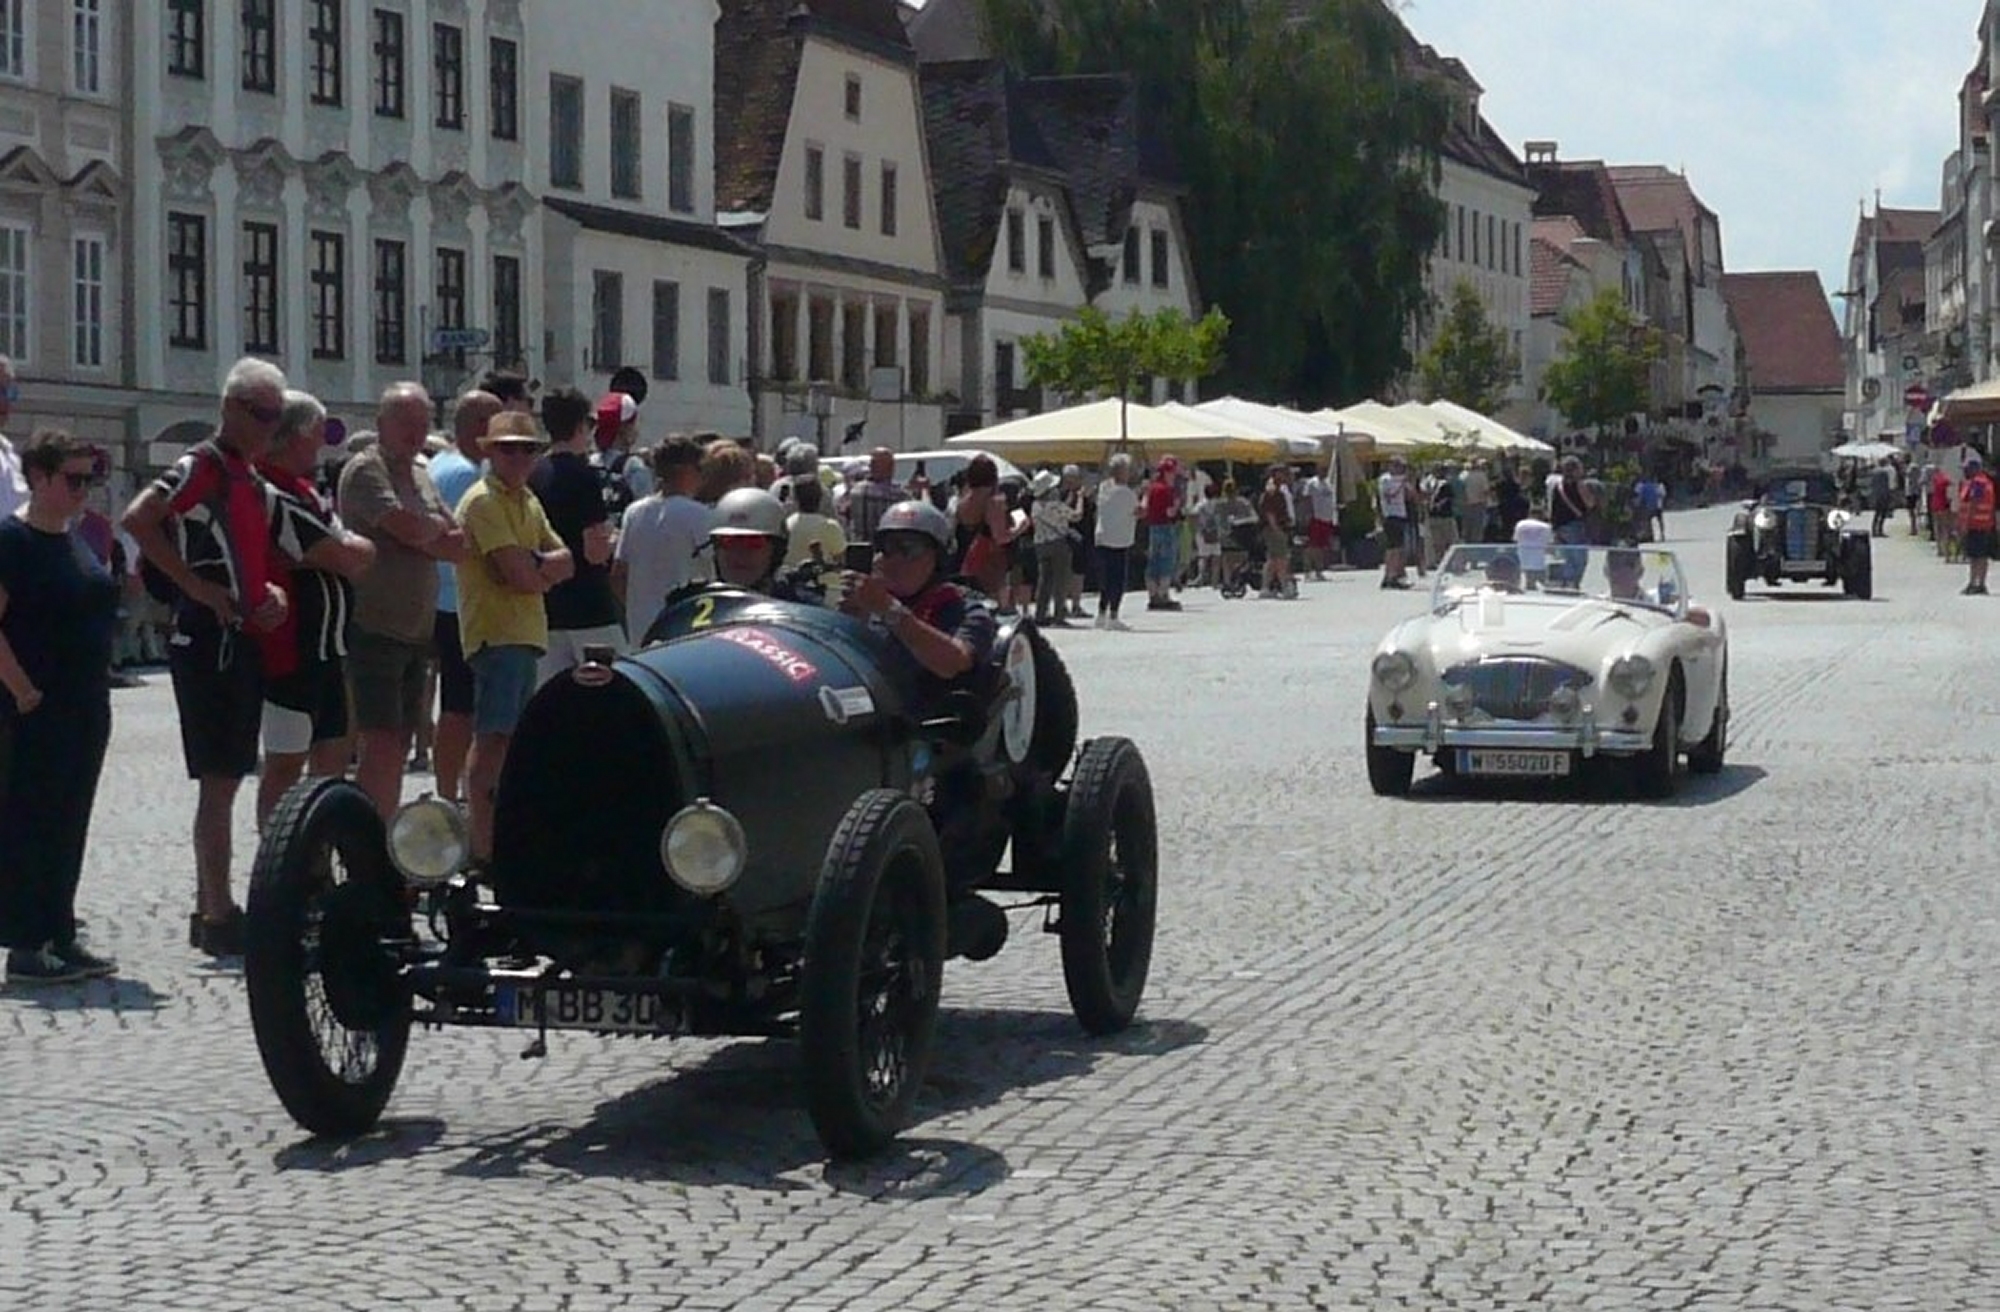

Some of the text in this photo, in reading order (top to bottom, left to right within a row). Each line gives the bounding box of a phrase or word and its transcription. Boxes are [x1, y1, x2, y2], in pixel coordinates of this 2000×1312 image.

[692, 598, 714, 628] 2
[1471, 754, 1483, 770] W
[518, 988, 542, 1022] M
[560, 989, 603, 1023] BB
